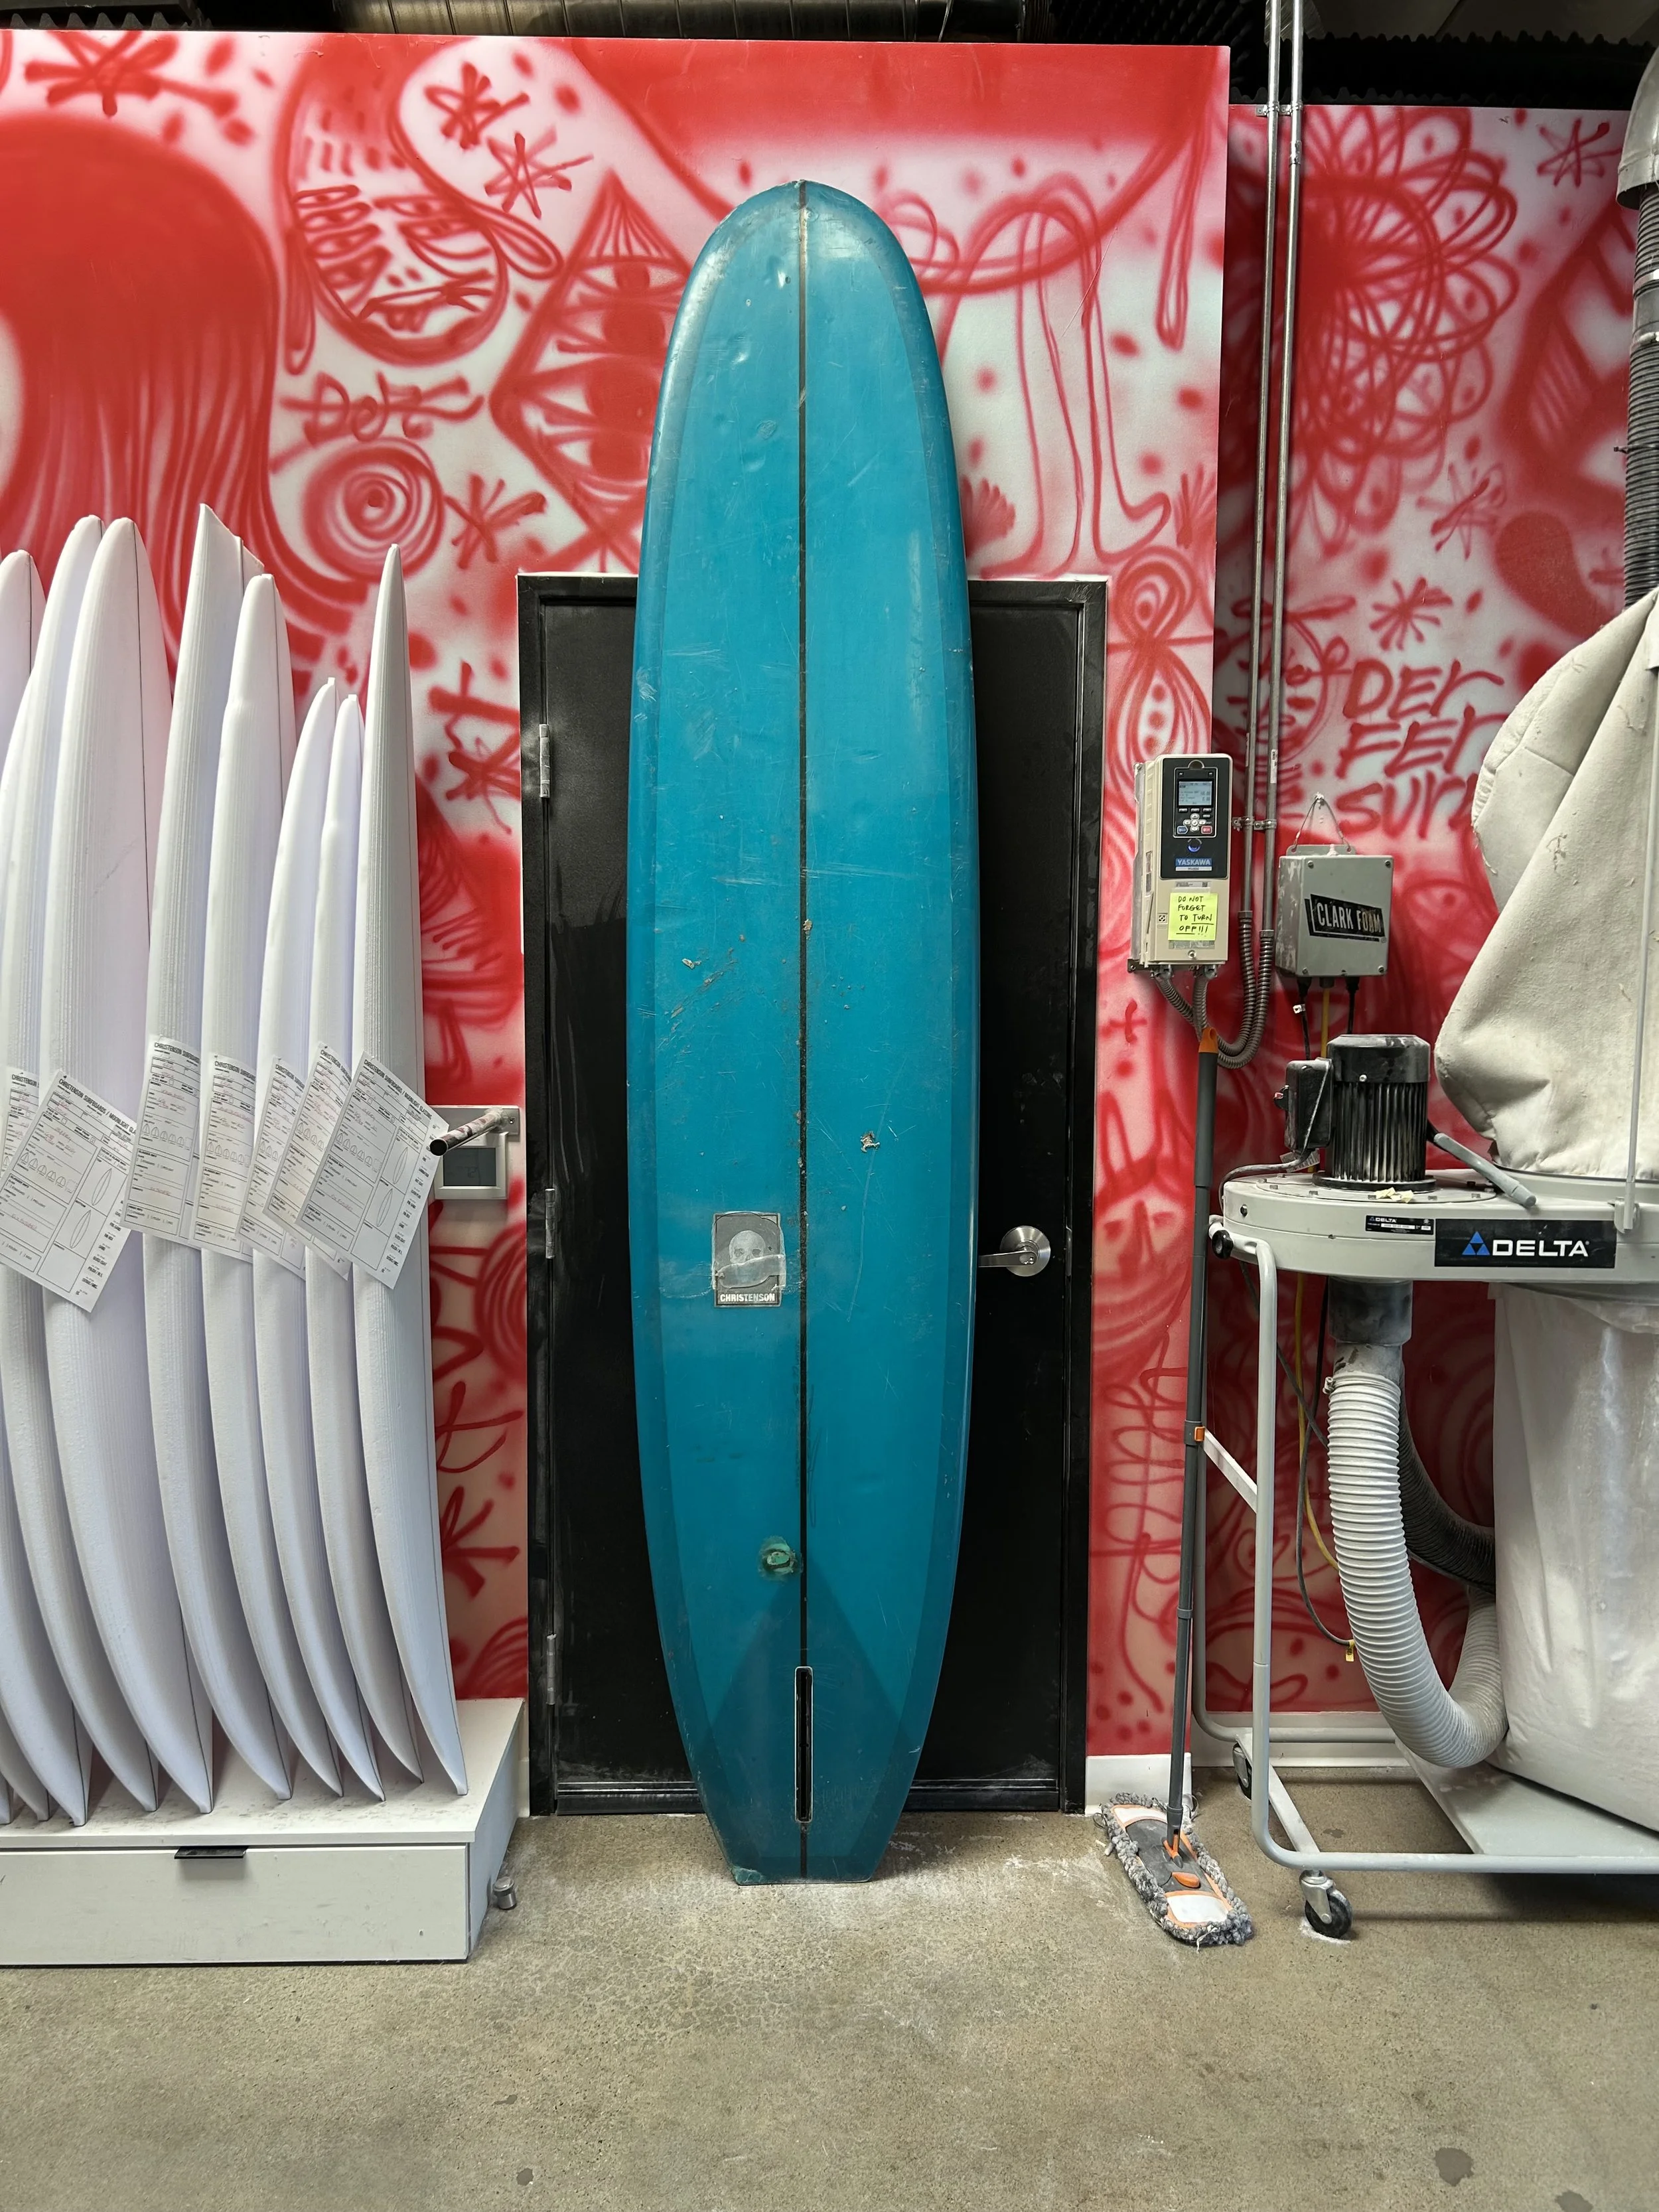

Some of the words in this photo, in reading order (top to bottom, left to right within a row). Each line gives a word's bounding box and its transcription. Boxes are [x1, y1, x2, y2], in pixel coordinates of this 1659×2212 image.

[1317, 902, 1354, 930] CLARK
[1356, 910, 1381, 933] FOAM
[1492, 1239, 1589, 1257] DELTA
[719, 1292, 776, 1303] CHRISTENSON
